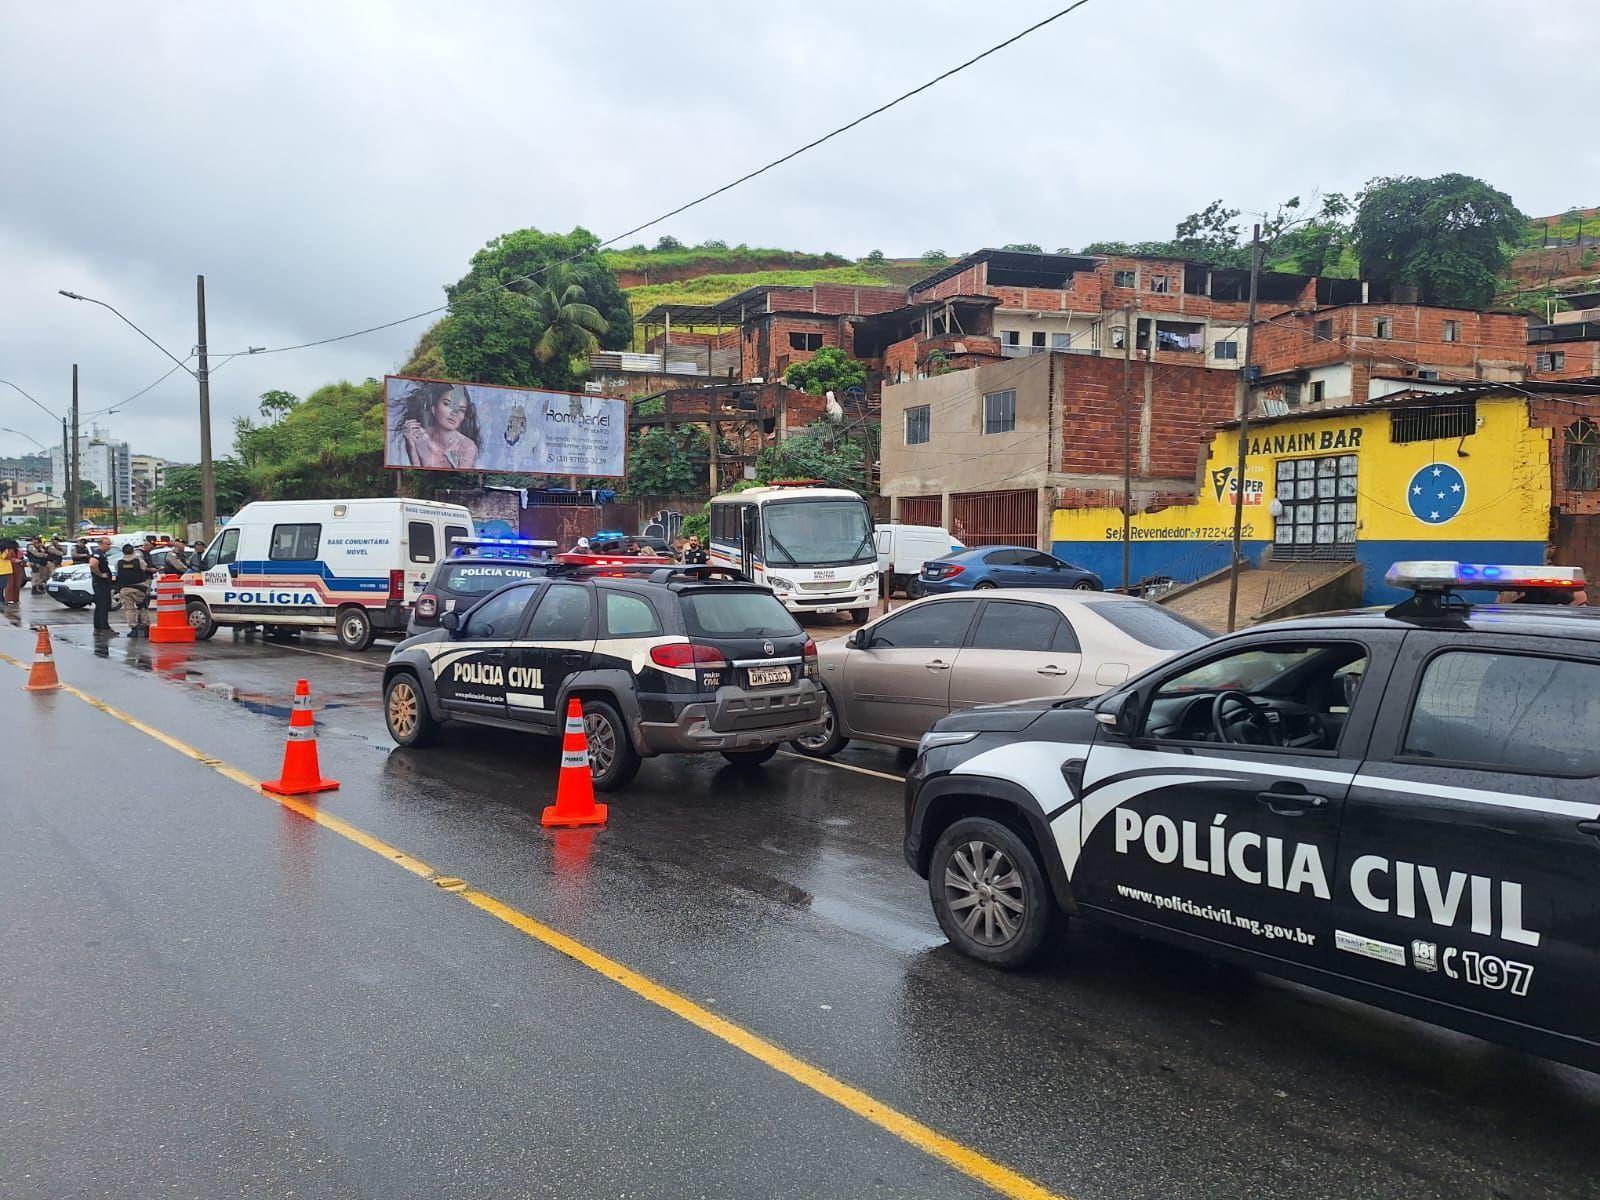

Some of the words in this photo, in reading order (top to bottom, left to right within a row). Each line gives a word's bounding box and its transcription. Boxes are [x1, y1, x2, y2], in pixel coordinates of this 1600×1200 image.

[1238, 432, 1315, 456] AANAIM
[1319, 427, 1363, 450] BAR
[1230, 478, 1263, 492] SPER
[1229, 493, 1262, 505] VLE
[1130, 526, 1191, 539] Revendedor
[460, 568, 503, 577] POLÍCIA
[505, 569, 532, 579] CIVIL
[224, 590, 318, 605] POLÍCIA
[453, 662, 504, 686] POLÍCIA
[508, 667, 544, 689] CIVIL
[1115, 807, 1331, 900] POLÍCIA
[1350, 854, 1540, 947] CIVIL
[1117, 884, 1316, 946] www.policiacivil.mg.gov.br
[1413, 942, 1435, 960] 181
[1462, 951, 1534, 996] 197
